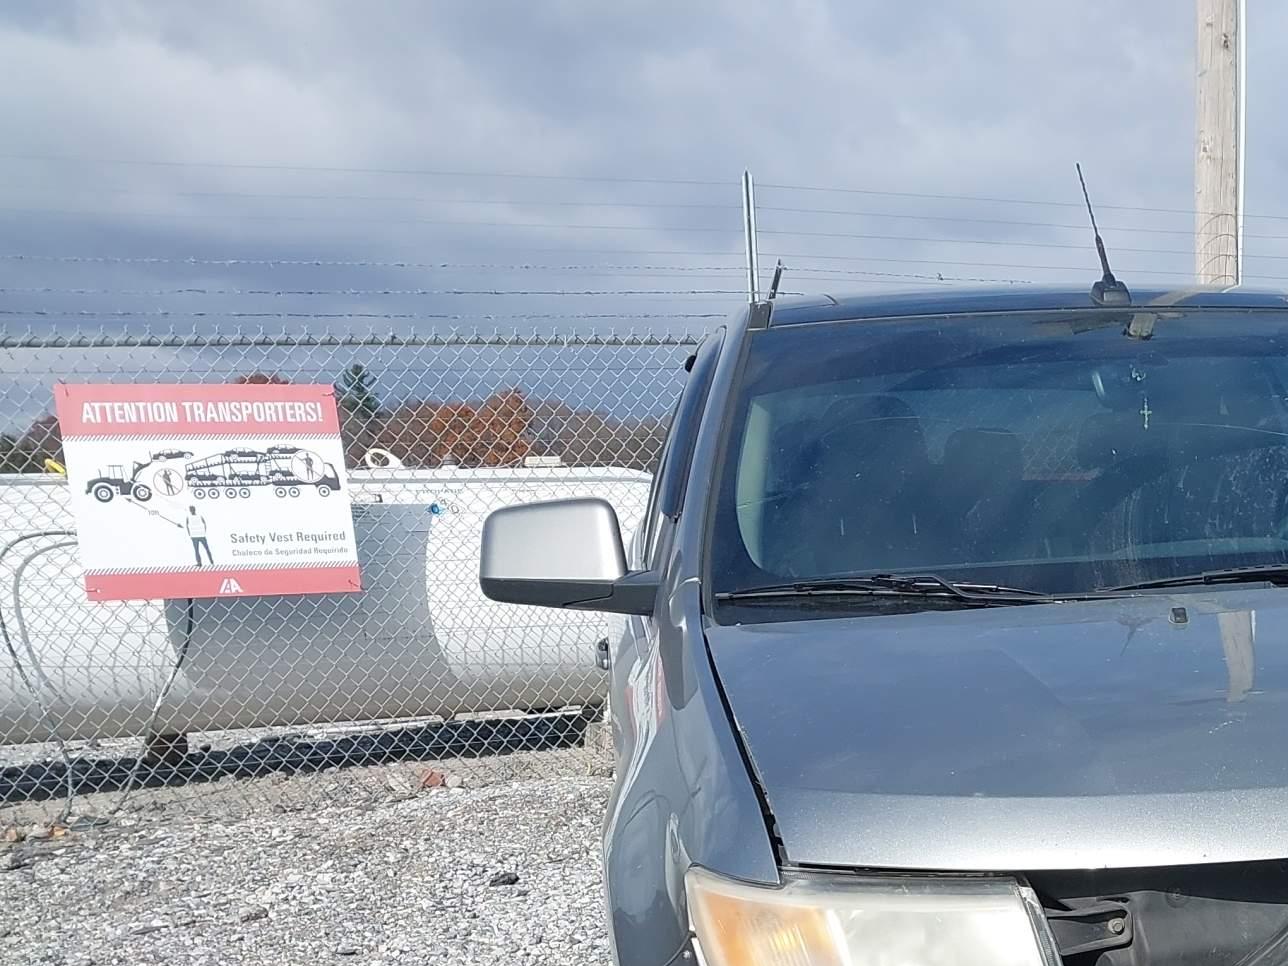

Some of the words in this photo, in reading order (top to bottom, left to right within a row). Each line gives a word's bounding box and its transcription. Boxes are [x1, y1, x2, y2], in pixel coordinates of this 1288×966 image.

[81, 402, 179, 424] ATTENTION
[181, 401, 324, 423] TRANSPORTERS!
[230, 533, 266, 545] Safety
[268, 532, 293, 543] Vest
[296, 530, 346, 544] Required
